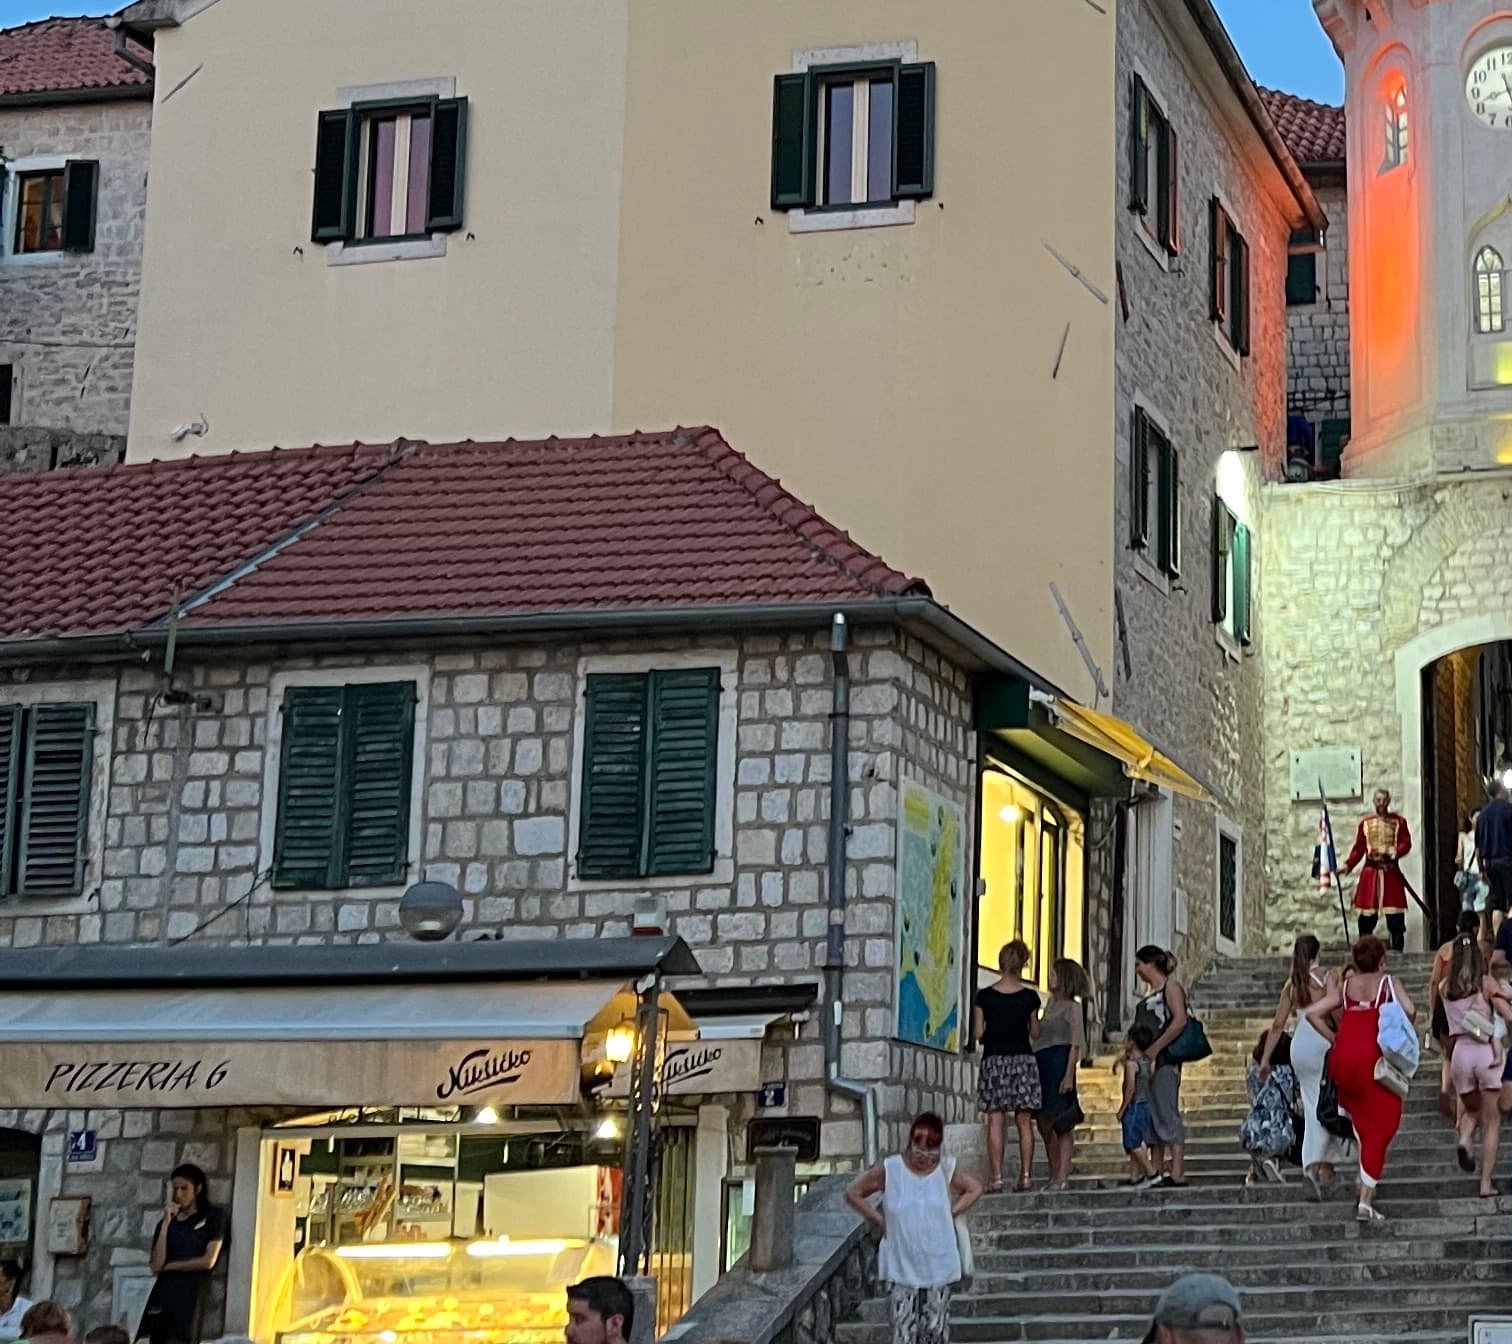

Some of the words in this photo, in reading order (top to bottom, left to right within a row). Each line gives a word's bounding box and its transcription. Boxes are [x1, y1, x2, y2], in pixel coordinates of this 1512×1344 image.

[1487, 57, 1496, 71] 11
[1473, 70, 1487, 84] 10
[1471, 87, 1480, 100] 9
[1476, 102, 1485, 115] 8
[1488, 113, 1497, 126] 7
[44, 1059, 202, 1092] PIZZERIA
[205, 1059, 231, 1090] 6
